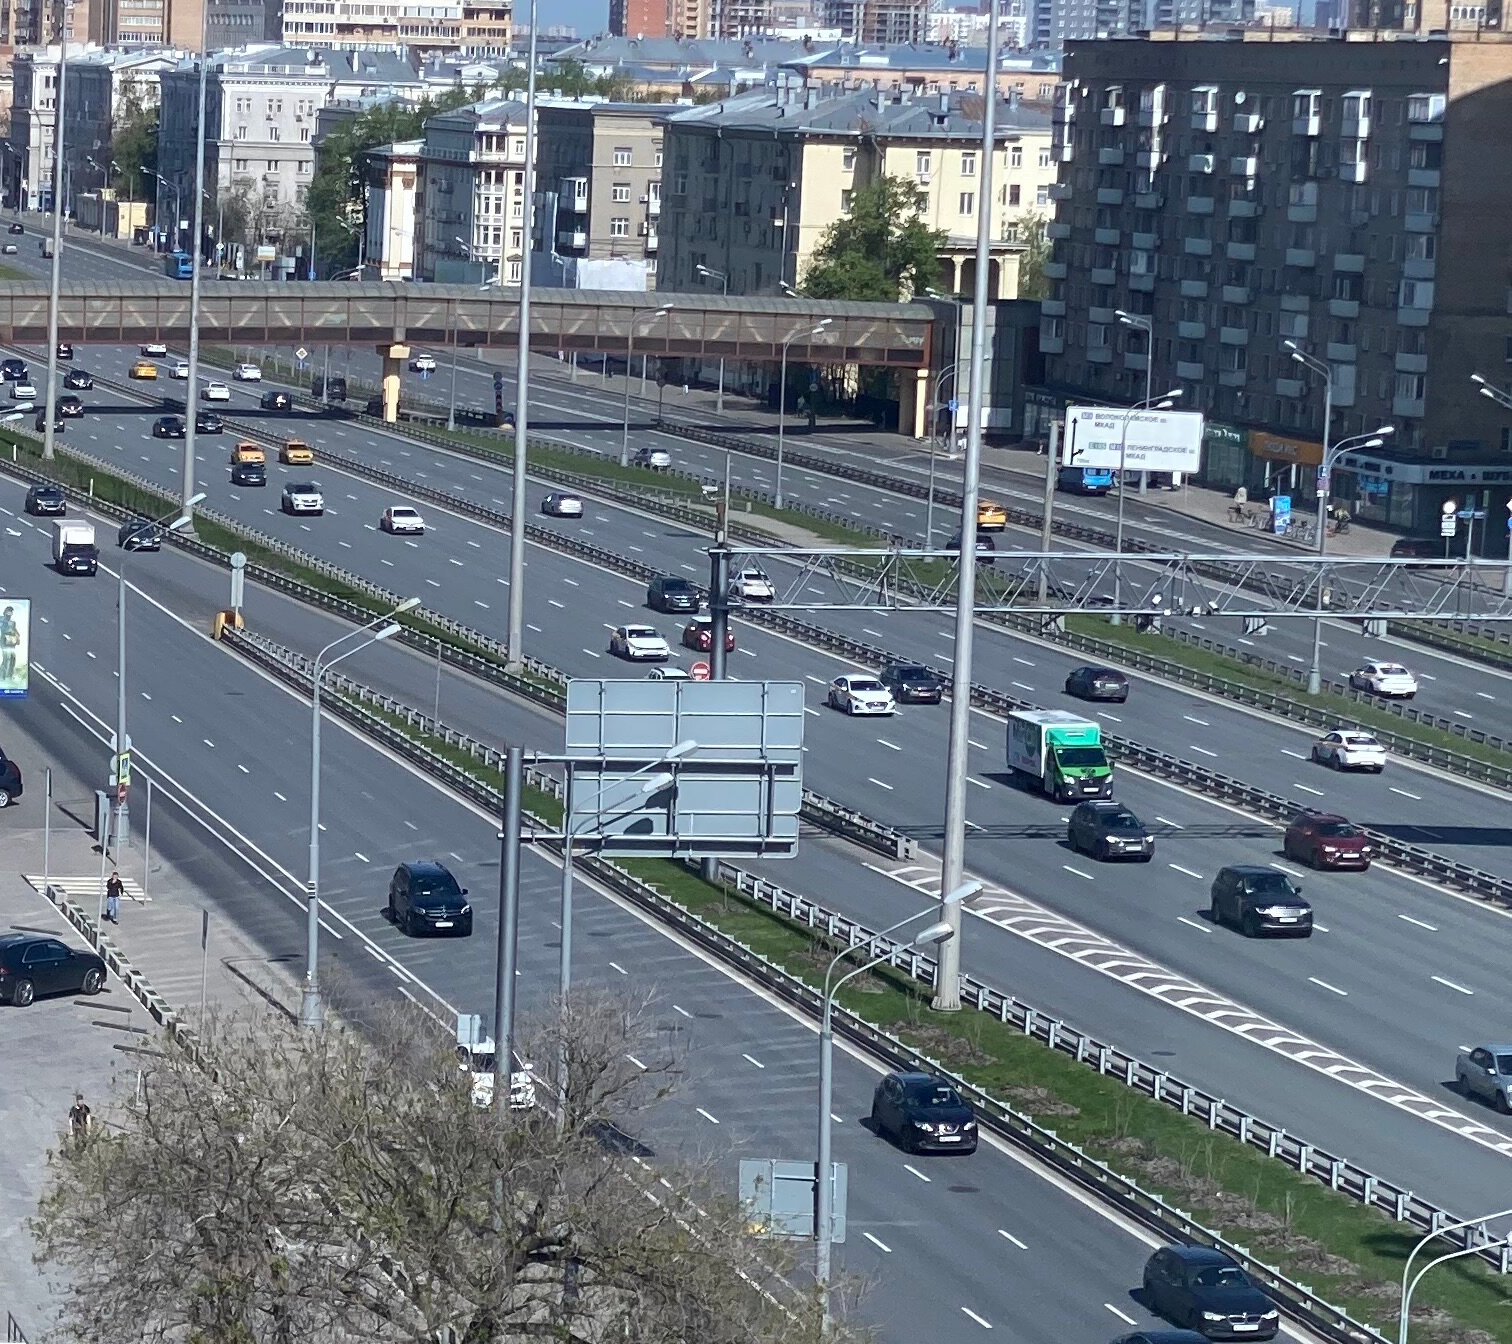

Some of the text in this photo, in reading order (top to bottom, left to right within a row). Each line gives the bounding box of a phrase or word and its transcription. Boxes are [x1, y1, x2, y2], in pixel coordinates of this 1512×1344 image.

[1094, 421, 1115, 430] МКАД
[1125, 453, 1146, 461] МКАД
[1429, 470, 1465, 480] МЕХА
